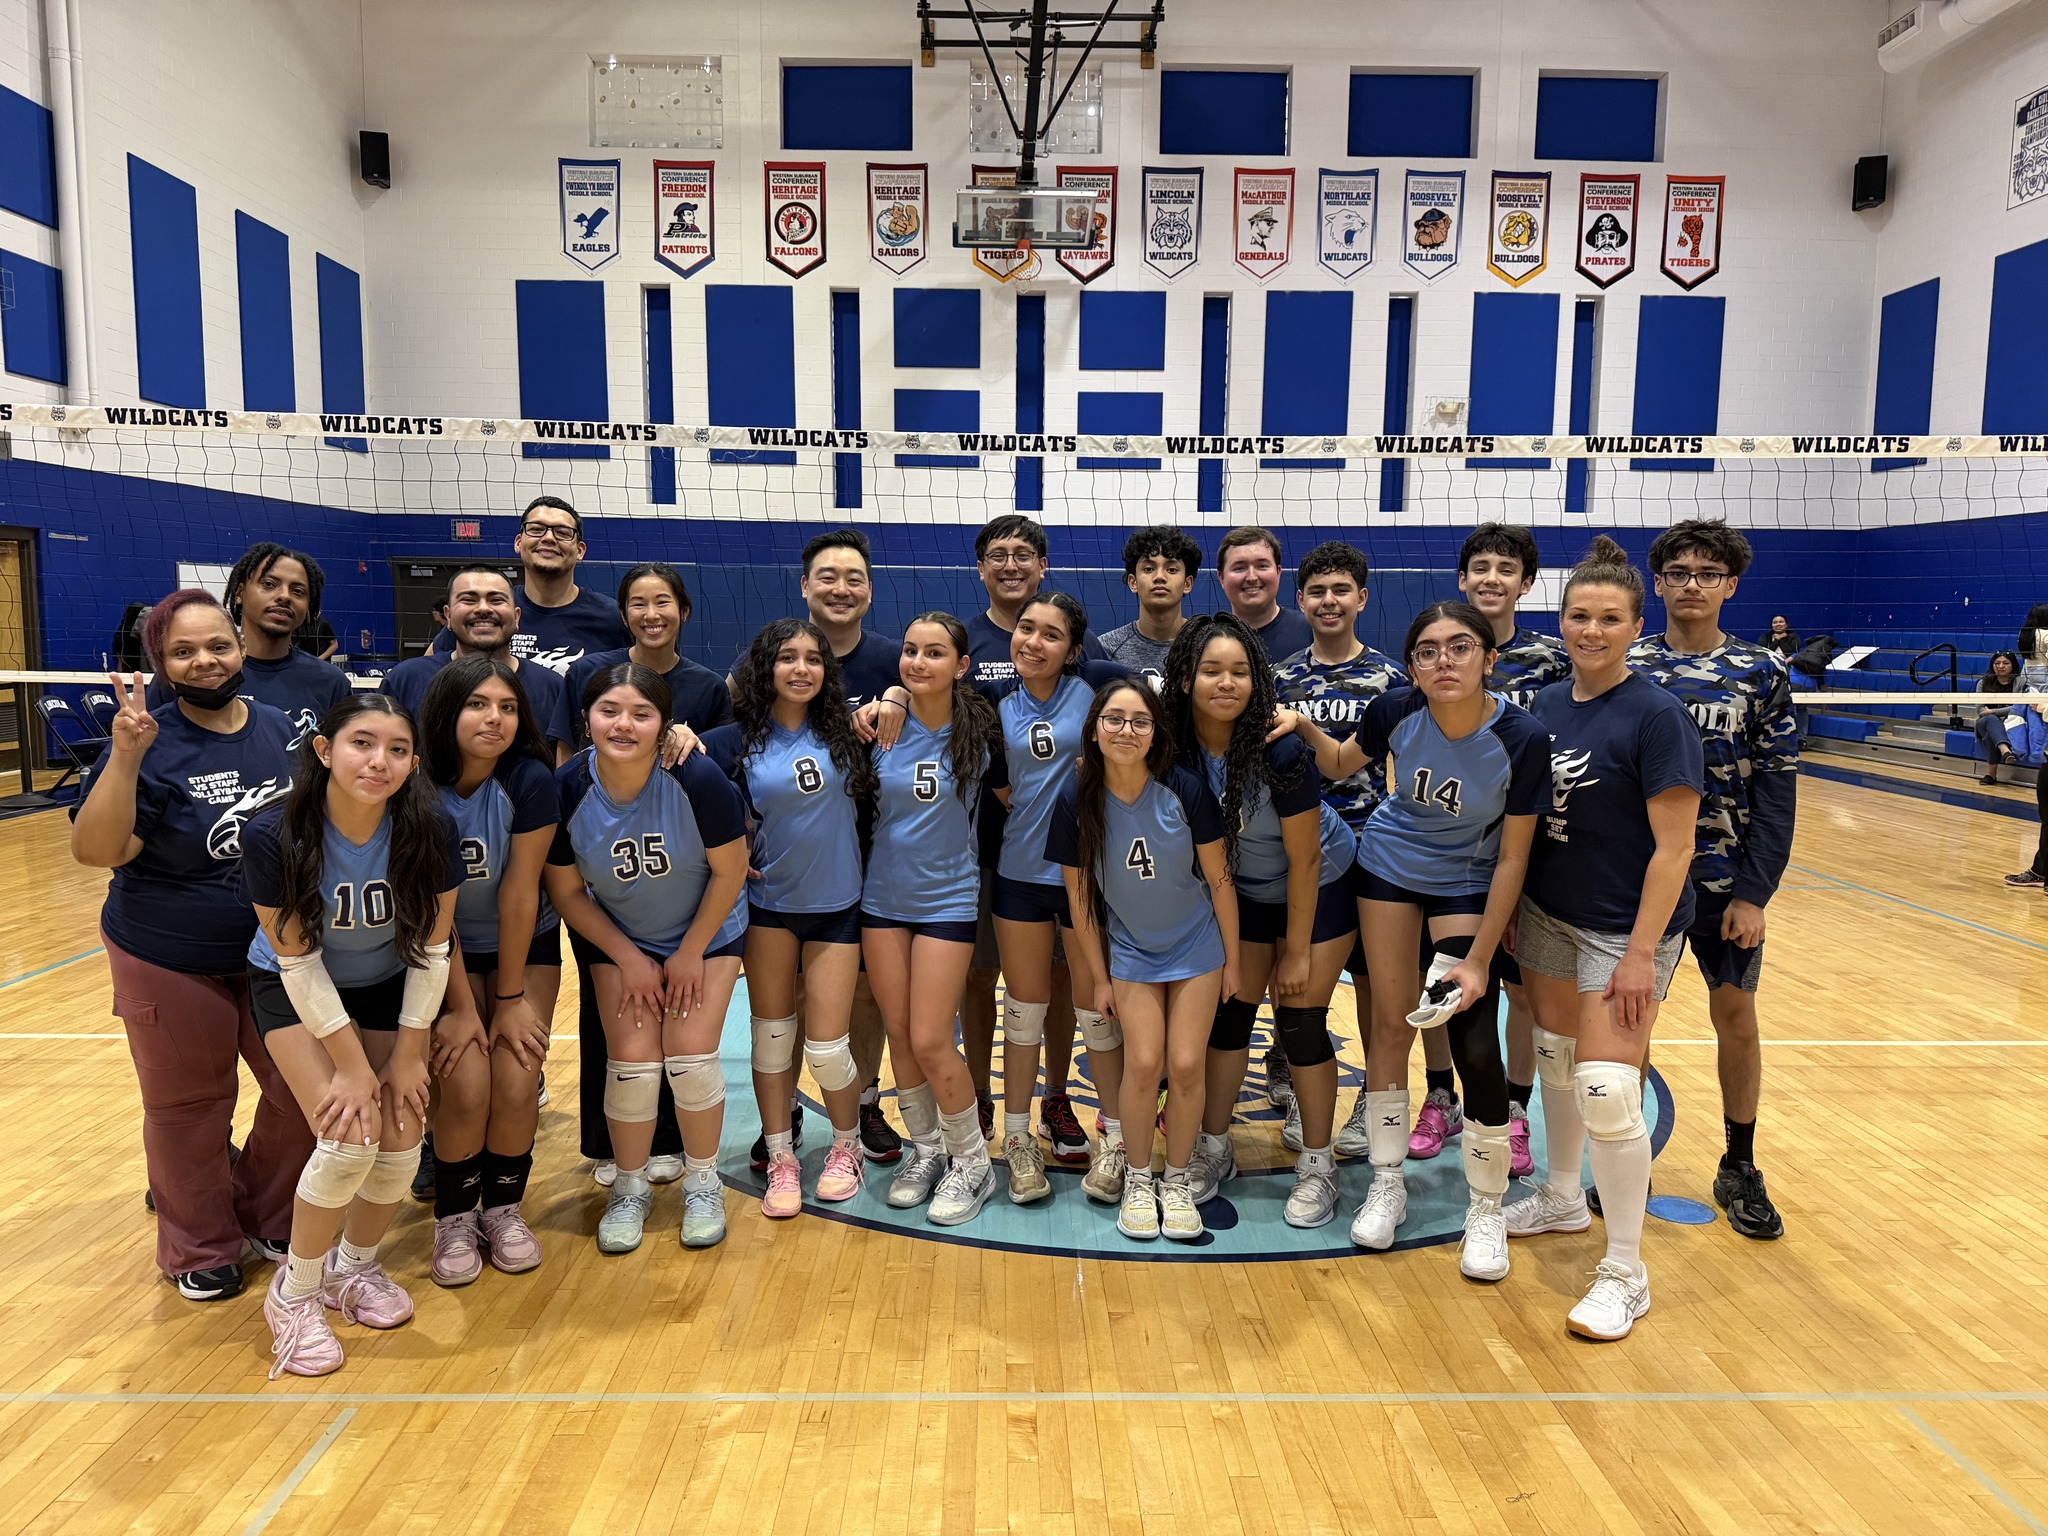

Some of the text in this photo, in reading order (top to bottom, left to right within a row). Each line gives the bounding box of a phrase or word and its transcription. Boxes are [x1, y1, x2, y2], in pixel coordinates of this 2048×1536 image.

[566, 182, 614, 191] GWENDOLYN BROOKS
[662, 184, 706, 192] FREEDOM
[772, 186, 818, 194] HERITAGE
[1150, 190, 1194, 198] LINCOLN
[1324, 192, 1371, 200] NORTHLAKE
[1410, 193, 1457, 202] ROOSEVELT
[1496, 194, 1544, 203] ROOSEVELT
[1585, 196, 1632, 205] STEVENSON
[1674, 198, 1713, 206] UNITY
[781, 207, 810, 222] HERITAGE
[663, 222, 707, 238] Patriots
[572, 244, 610, 252] EAGLES
[774, 247, 818, 256] FALCONS
[878, 248, 919, 256] SAILORS
[982, 250, 1024, 259] TIGERS
[1063, 251, 1108, 260] JAYHAWKS
[1494, 254, 1540, 263] BULLDOGS
[1585, 257, 1626, 265] PIRATES
[1669, 258, 1710, 267] TIGERS
[105, 408, 228, 427] WILDCATS
[319, 415, 443, 435] WILDCATS
[534, 421, 656, 441] WILDCATS
[748, 429, 868, 448] WILDCATS
[957, 434, 1076, 452] WILDCATS
[1374, 436, 1494, 453] WILDCATS
[1166, 437, 1285, 454] WILDCATS
[1585, 437, 1703, 453] WILDCATS
[1792, 437, 1910, 453] WILDCATS
[1029, 722, 1056, 760] 6
[188, 771, 240, 784] STUDENTS
[792, 756, 824, 794] 8
[193, 779, 239, 791] VS STAFF
[913, 761, 939, 802] 5
[189, 786, 247, 798] VOLLEYBALL
[1412, 766, 1462, 818] 14
[208, 795, 236, 804] GAME
[1546, 816, 1567, 826] BUMP
[1551, 824, 1563, 833] SET
[1547, 830, 1568, 842] SPIKE!
[460, 838, 490, 881] 2
[610, 833, 672, 882] 35
[1125, 837, 1155, 881] 4
[331, 879, 396, 929] 10
